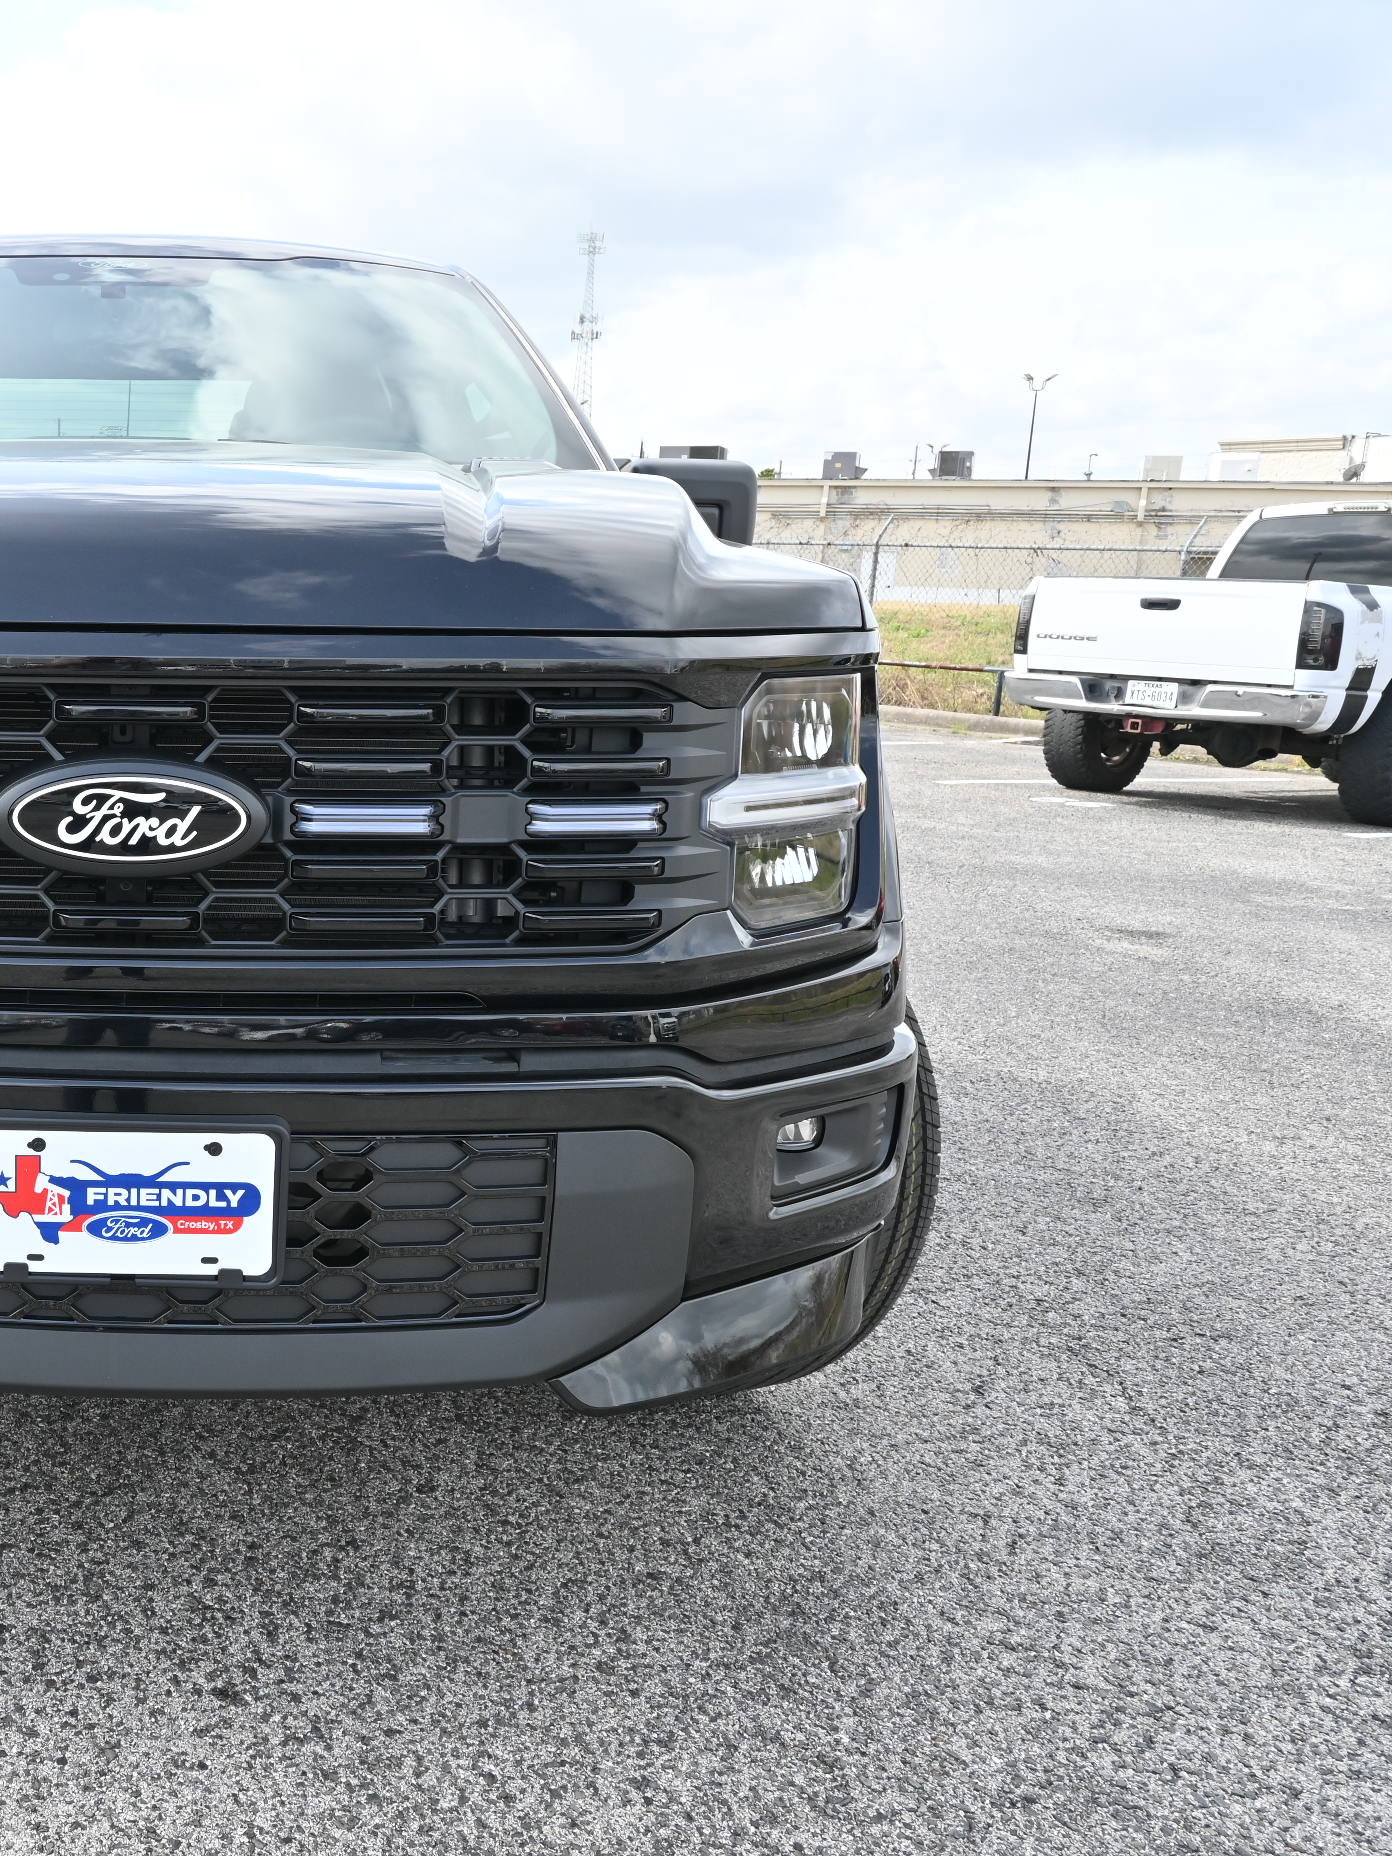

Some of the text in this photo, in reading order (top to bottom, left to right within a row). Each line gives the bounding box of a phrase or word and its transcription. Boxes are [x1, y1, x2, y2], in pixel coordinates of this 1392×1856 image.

[1036, 632, 1098, 642] DODGE
[57, 788, 202, 847] Ford
[86, 1187, 246, 1208] FRIENDLY
[101, 1216, 153, 1238] Ford
[177, 1220, 234, 1231] Crosby, TX
